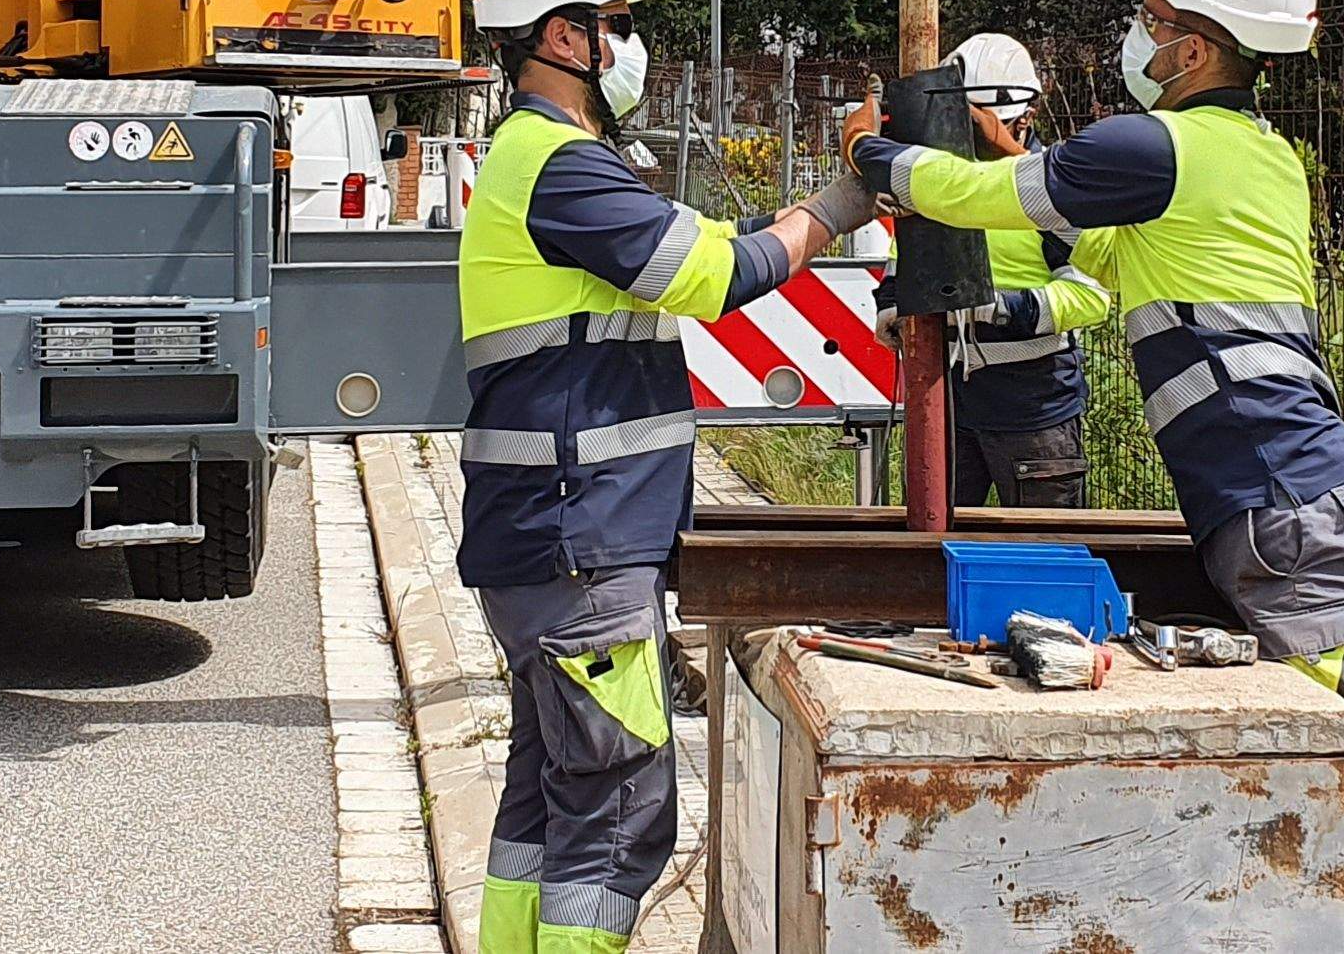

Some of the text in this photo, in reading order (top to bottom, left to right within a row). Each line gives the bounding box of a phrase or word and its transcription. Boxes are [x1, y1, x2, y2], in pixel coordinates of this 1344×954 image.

[262, 11, 414, 34] AC 45 CITY
